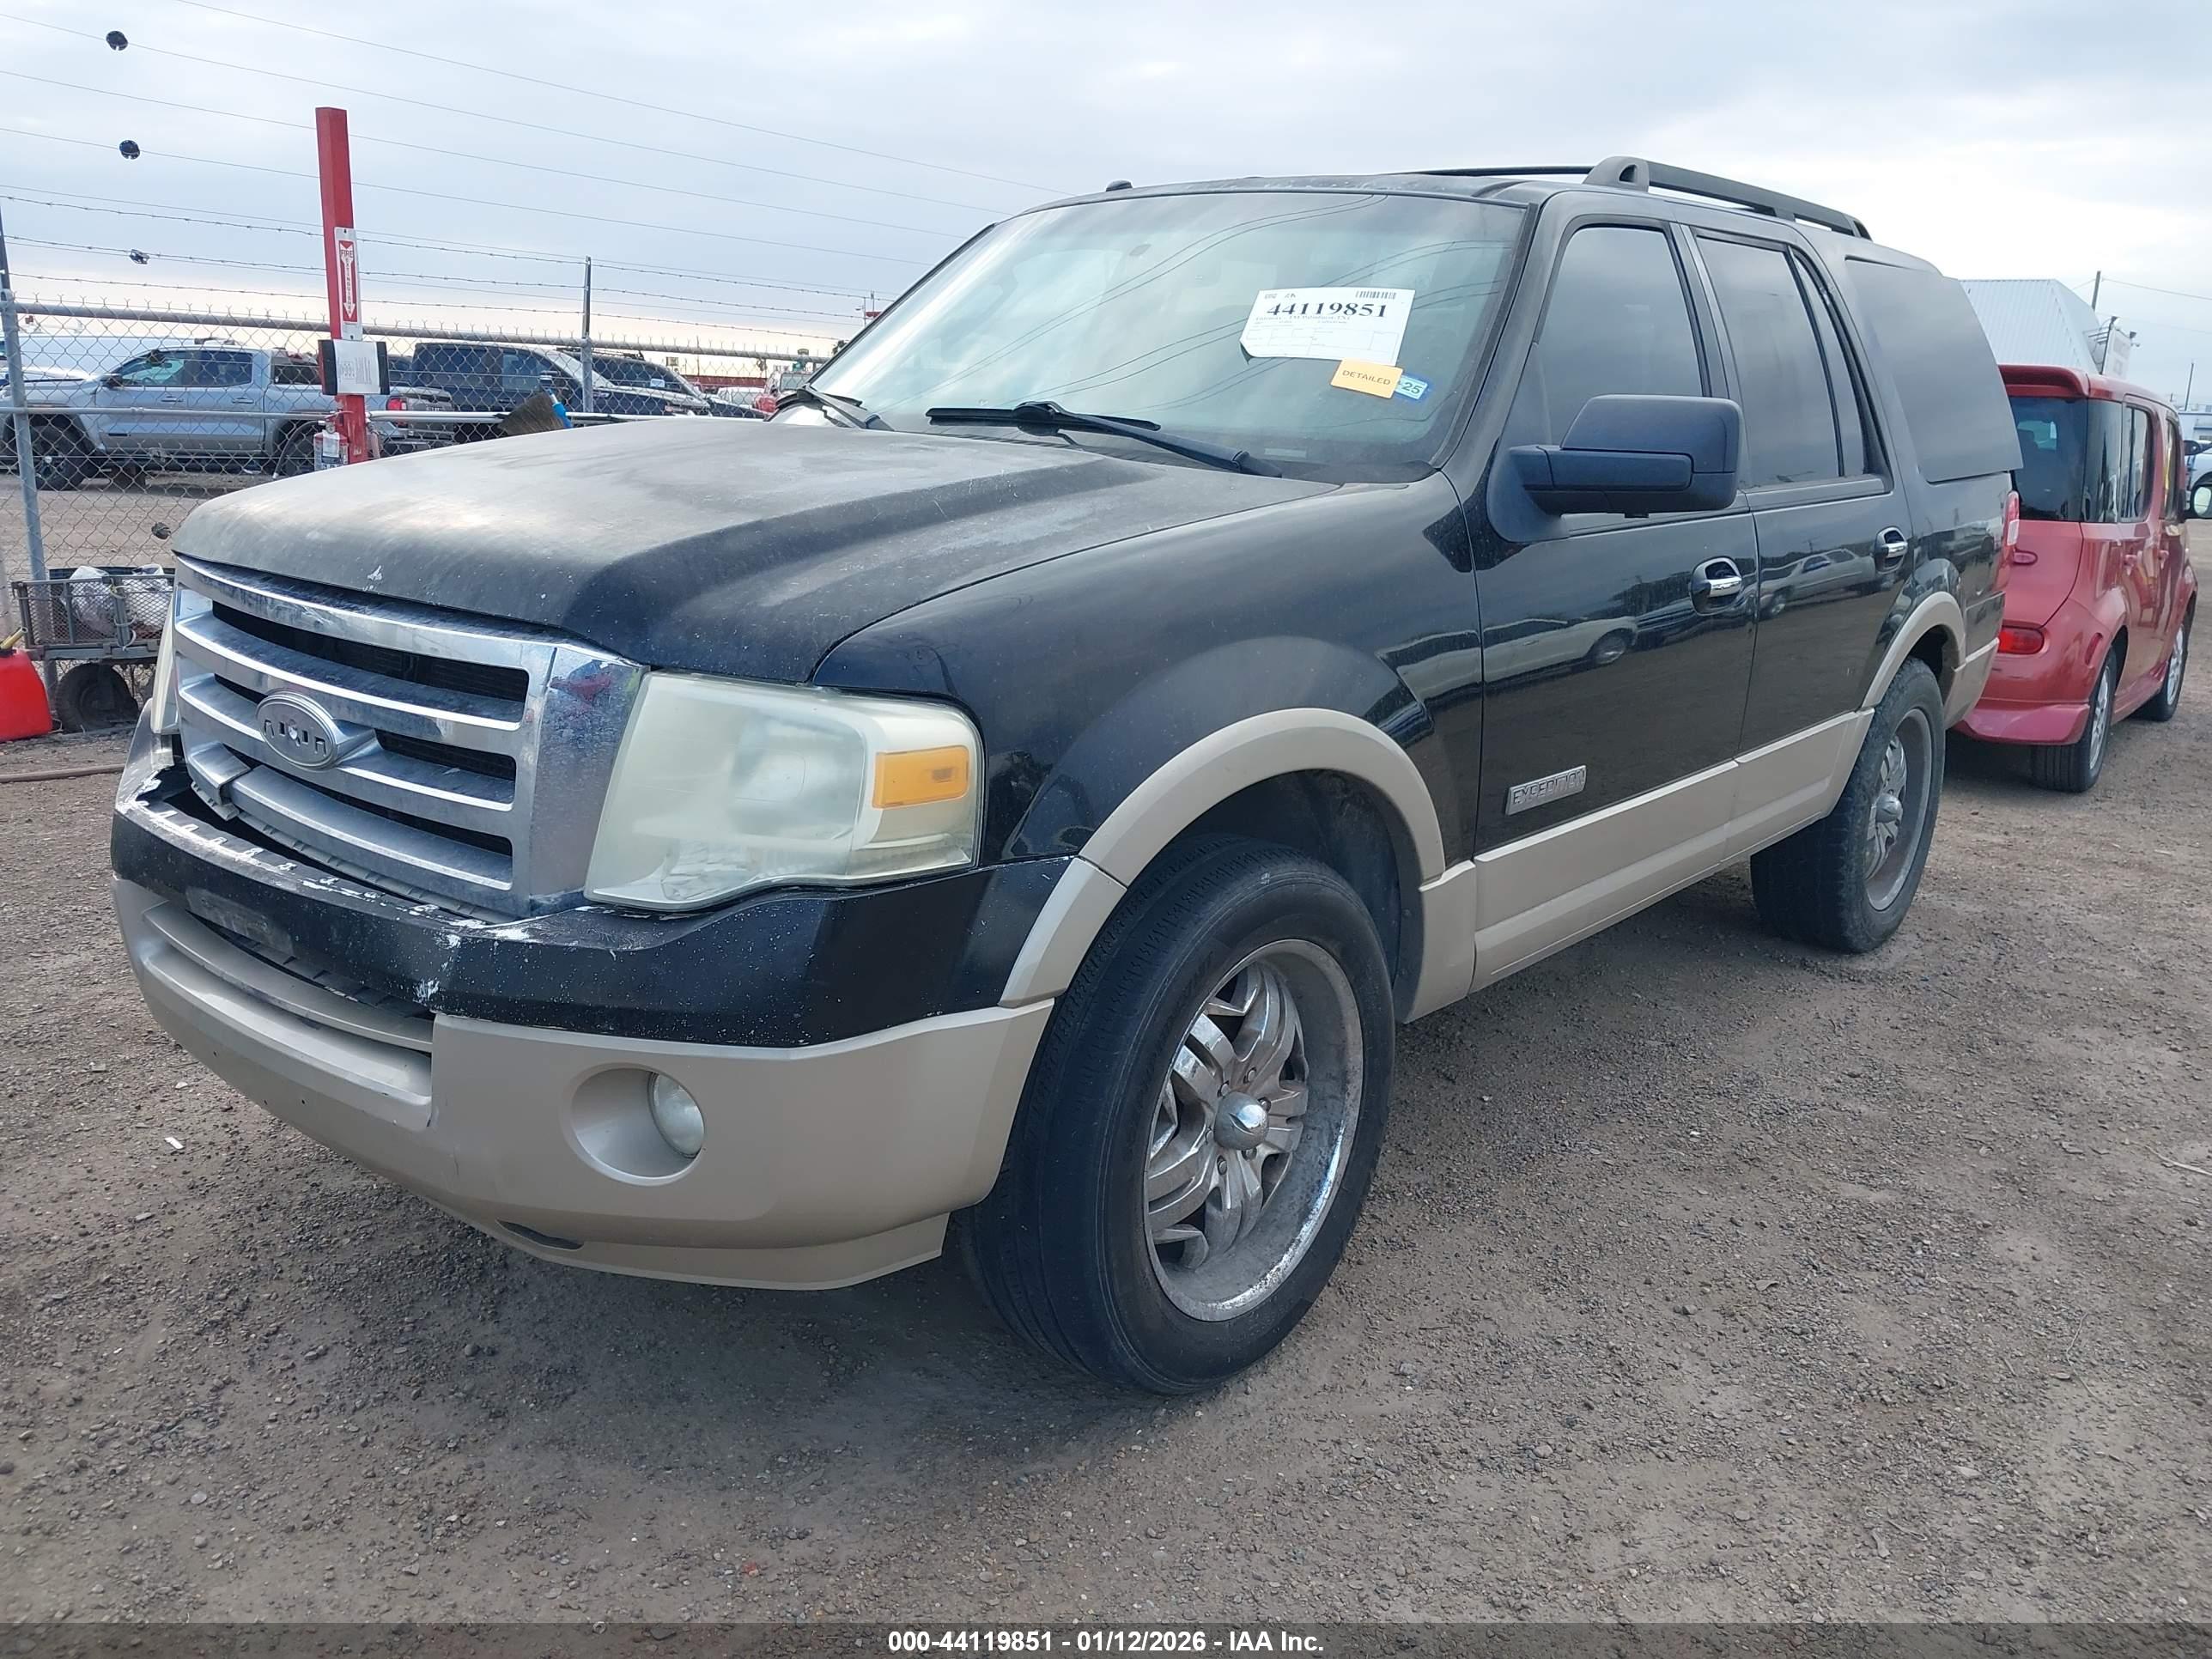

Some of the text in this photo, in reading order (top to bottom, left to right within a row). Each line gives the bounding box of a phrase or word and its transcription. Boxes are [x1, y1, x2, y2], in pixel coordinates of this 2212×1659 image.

[340, 249, 353, 258] FIRE
[1267, 302, 1387, 318] 44119851
[1342, 369, 1391, 386] DETAILED
[1401, 381, 1422, 394] 25
